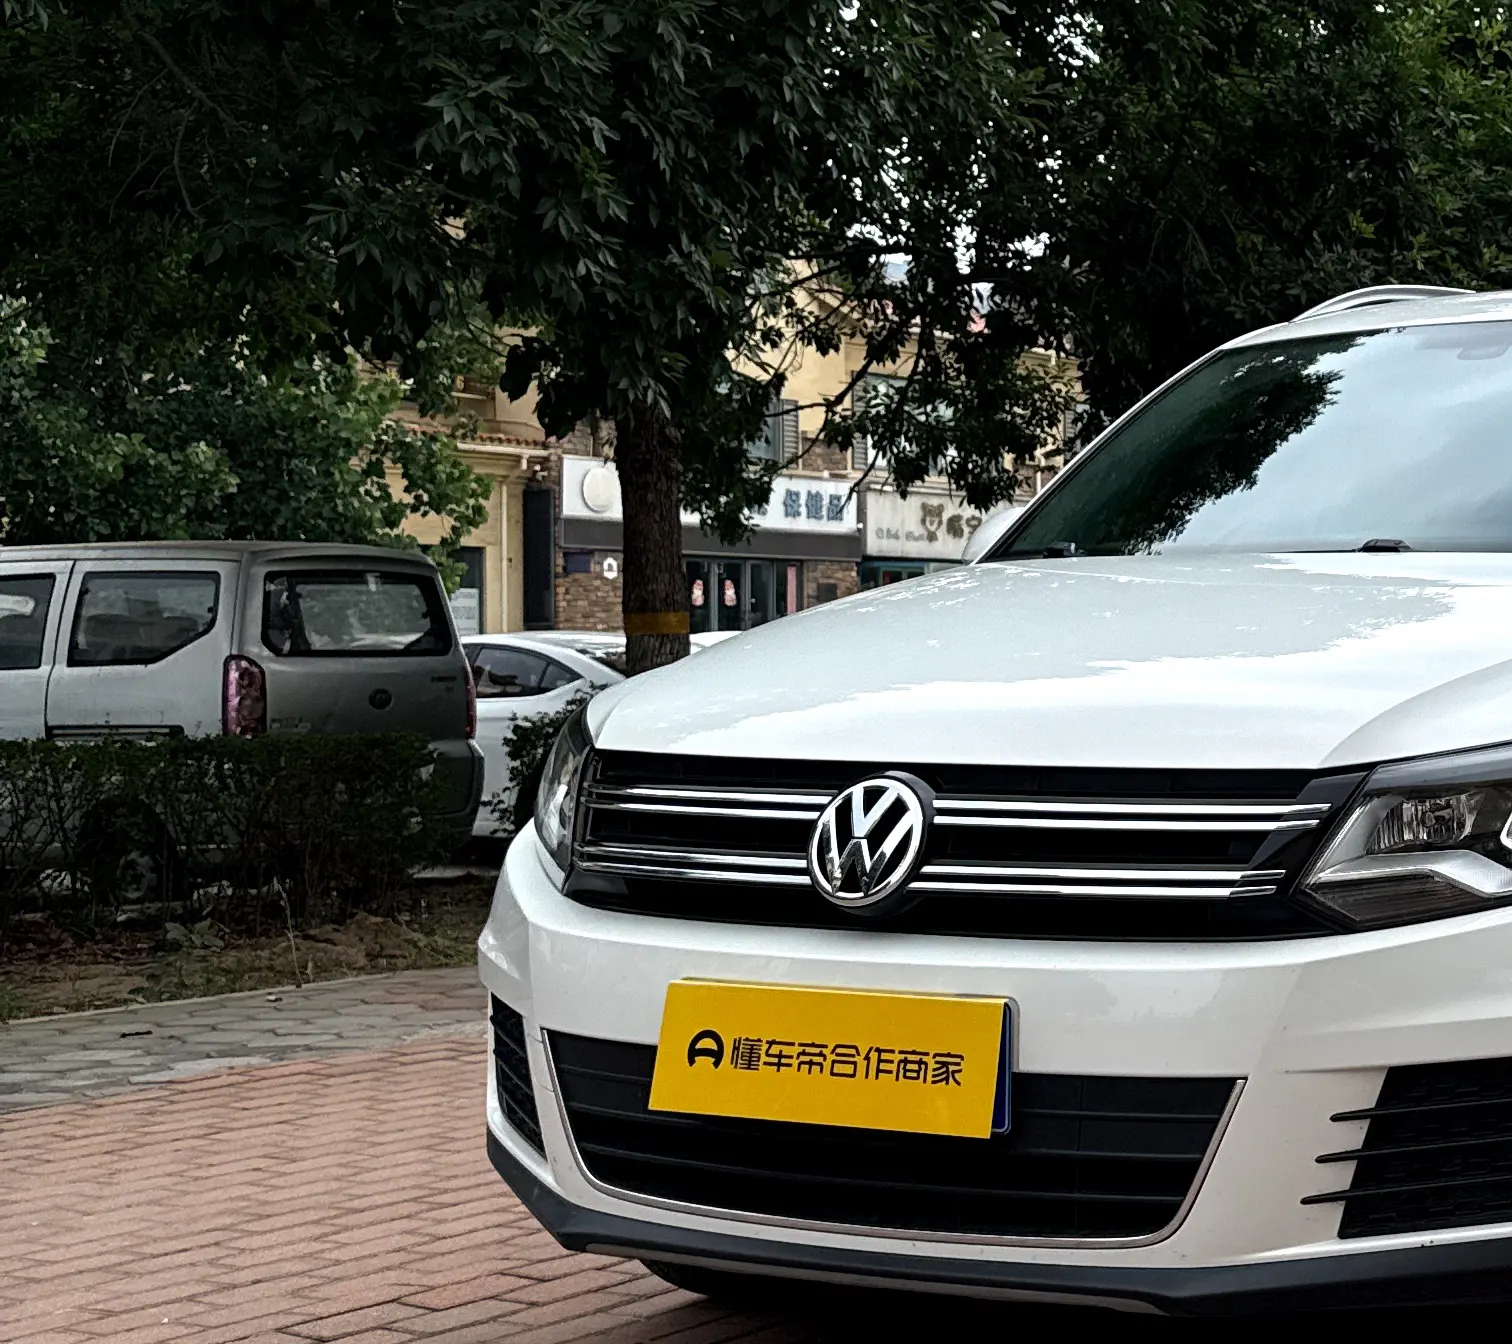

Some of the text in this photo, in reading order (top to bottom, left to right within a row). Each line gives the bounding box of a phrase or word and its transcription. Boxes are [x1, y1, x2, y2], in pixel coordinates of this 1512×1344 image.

[783, 488, 844, 521] 保健品
[731, 1037, 966, 1087] 懂车帝合作商家
